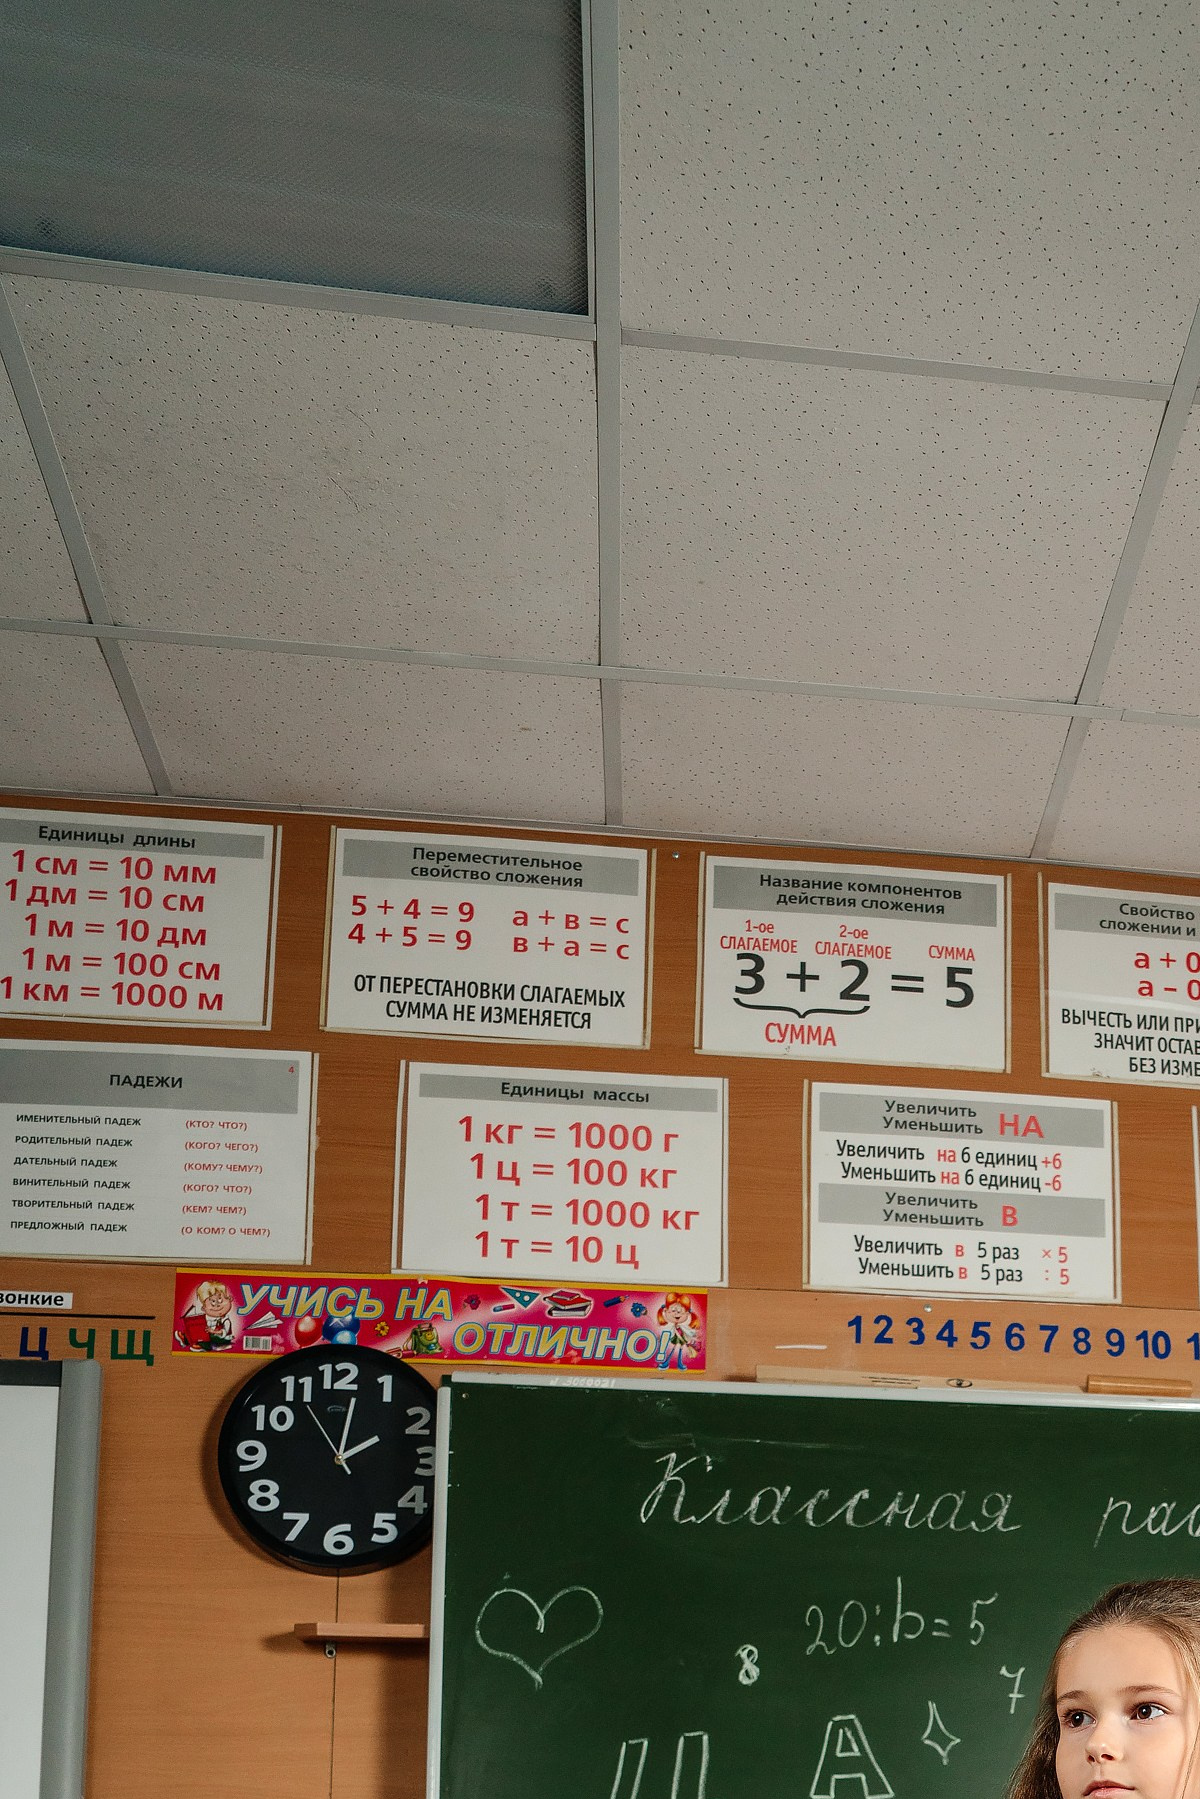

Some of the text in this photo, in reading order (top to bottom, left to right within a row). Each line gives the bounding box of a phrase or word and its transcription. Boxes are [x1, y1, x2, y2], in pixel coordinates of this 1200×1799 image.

[39, 825, 195, 848] Единицы длины
[12, 850, 216, 884] 1 см 10 мм
[412, 847, 583, 871] Переместительное
[411, 865, 583, 887] свойство сложения
[760, 874, 962, 899] Название компонентов
[776, 892, 944, 914] действия сложения
[1119, 903, 1195, 920] Свойство
[745, 919, 868, 939] 1-ое 2-ое
[1099, 919, 1181, 935] сложении
[1186, 927, 1196, 937] и
[720, 935, 975, 961] СЛАГАЕМОЕ СЛАГАЕМОЕ СУММА
[354, 974, 625, 1007] ОТ ПЕРЕСТАНОВКИ СЛАГАЕМЫХ
[735, 953, 974, 1008] 3 2 5
[386, 1000, 591, 1029] СУММА НЕ ИЗМЕНЯЕТСЯ
[1062, 1008, 1132, 1028] ВЫЧЕСТЬ
[1137, 1014, 1169, 1031] ИЛИ
[765, 1022, 836, 1046] СУММА
[1094, 1032, 1154, 1052] ЗНАЧИТ
[1129, 1057, 1156, 1073] БЕЗ
[110, 1074, 182, 1089] ПАДЕЖИ
[501, 1082, 649, 1103] Единицы массы
[885, 1100, 977, 1117] Увеличить
[16, 1114, 247, 1132] ИМЕНИТЕЛЬНЫЙ ПАДЕЖ (КТО? ЧТО?)
[459, 1116, 679, 1152] 1 кг 1000 г
[883, 1113, 1044, 1138] Уменьшить НА
[15, 1136, 258, 1153] РОДИТЕЛЬНЫЙ ПАДЕЖ (КОГО? ЧЕГО?)
[836, 1139, 925, 1160] Увеличить
[938, 1149, 956, 1163] на
[961, 1147, 971, 1163] 6
[975, 1151, 1037, 1171] единиц
[13, 1157, 263, 1174] ДАТЕЛЬНЫЙ ПАДЕЖ (КОМУ? ЧЕМУ?)
[237, 1283, 454, 1321] УЧИСЬ НА
[452, 1322, 671, 1363] ОТЛИЧНО!
[848, 1316, 861, 1343] 1
[874, 1315, 893, 1343] 2
[906, 1318, 925, 1345] 3
[936, 1320, 957, 1347] 4
[971, 1322, 990, 1349] 5
[1006, 1323, 1025, 1351] 6
[1040, 1325, 1058, 1352] 7
[1074, 1328, 1091, 1354] 8
[1106, 1329, 1124, 1357] 9
[1136, 1331, 1171, 1359] 10
[318, 1362, 359, 1391] 12
[236, 1440, 267, 1472] 9
[640, 1452, 1022, 1533] Классная
